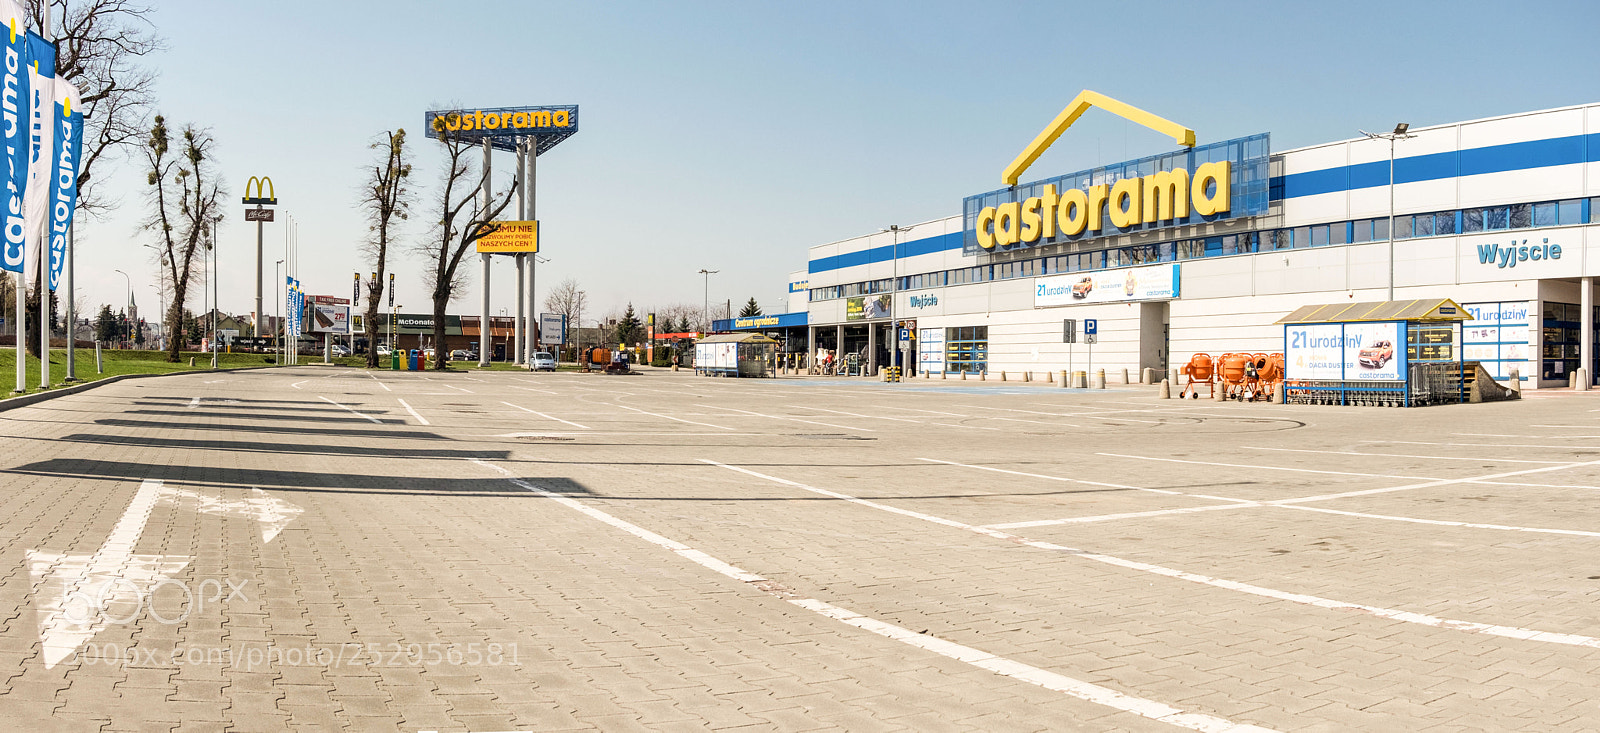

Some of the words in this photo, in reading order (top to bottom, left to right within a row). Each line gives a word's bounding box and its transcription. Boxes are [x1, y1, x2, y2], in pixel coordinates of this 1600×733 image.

[976, 160, 1231, 249] castorama
[1477, 237, 1562, 269] Wyjście
[1037, 284, 1046, 297] 21
[910, 294, 938, 309] Wejście
[1086, 320, 1095, 333] P
[901, 330, 908, 340] P
[1292, 331, 1307, 348] 21
[1359, 371, 1395, 379] castorama
